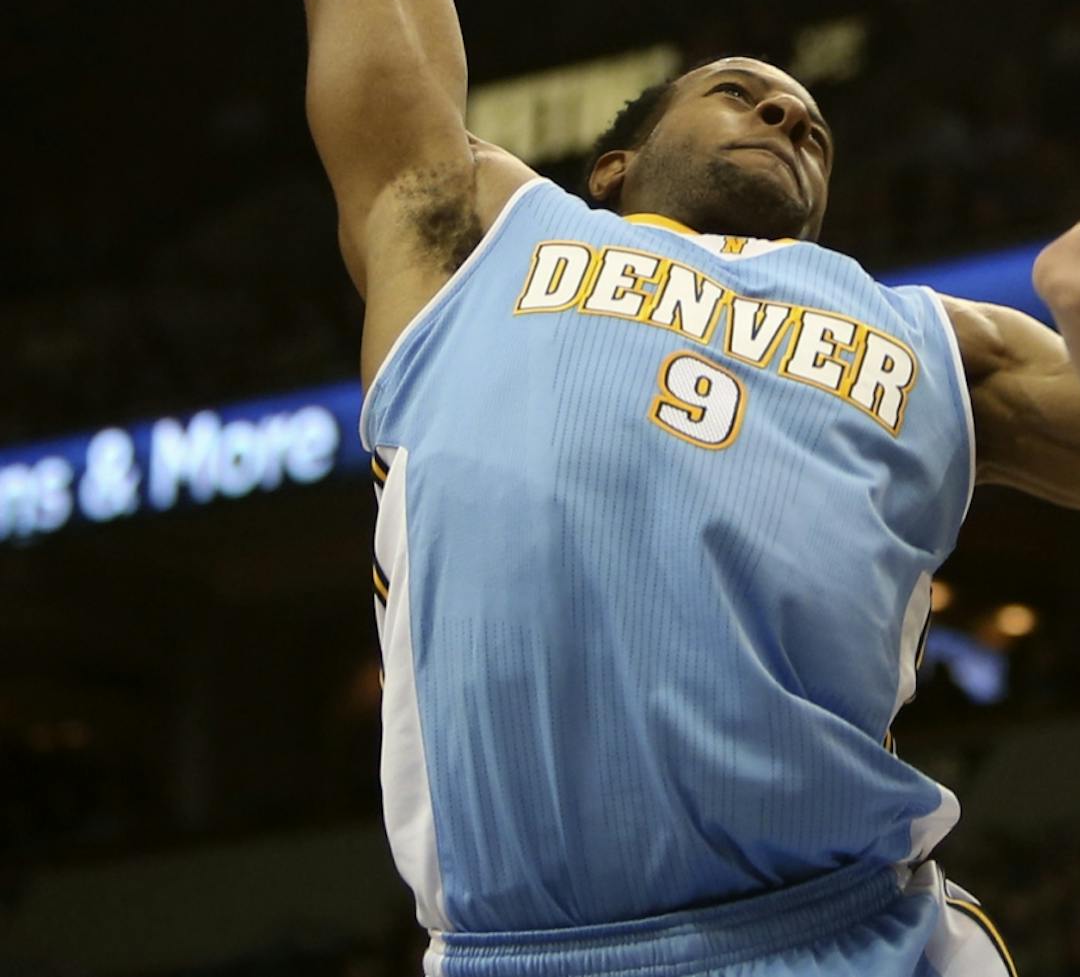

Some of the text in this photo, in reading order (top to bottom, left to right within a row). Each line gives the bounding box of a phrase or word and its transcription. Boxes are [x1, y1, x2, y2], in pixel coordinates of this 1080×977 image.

[513, 240, 918, 438] DENVER
[648, 350, 748, 451] 9
[78, 428, 139, 522] &
[149, 406, 339, 510] More
